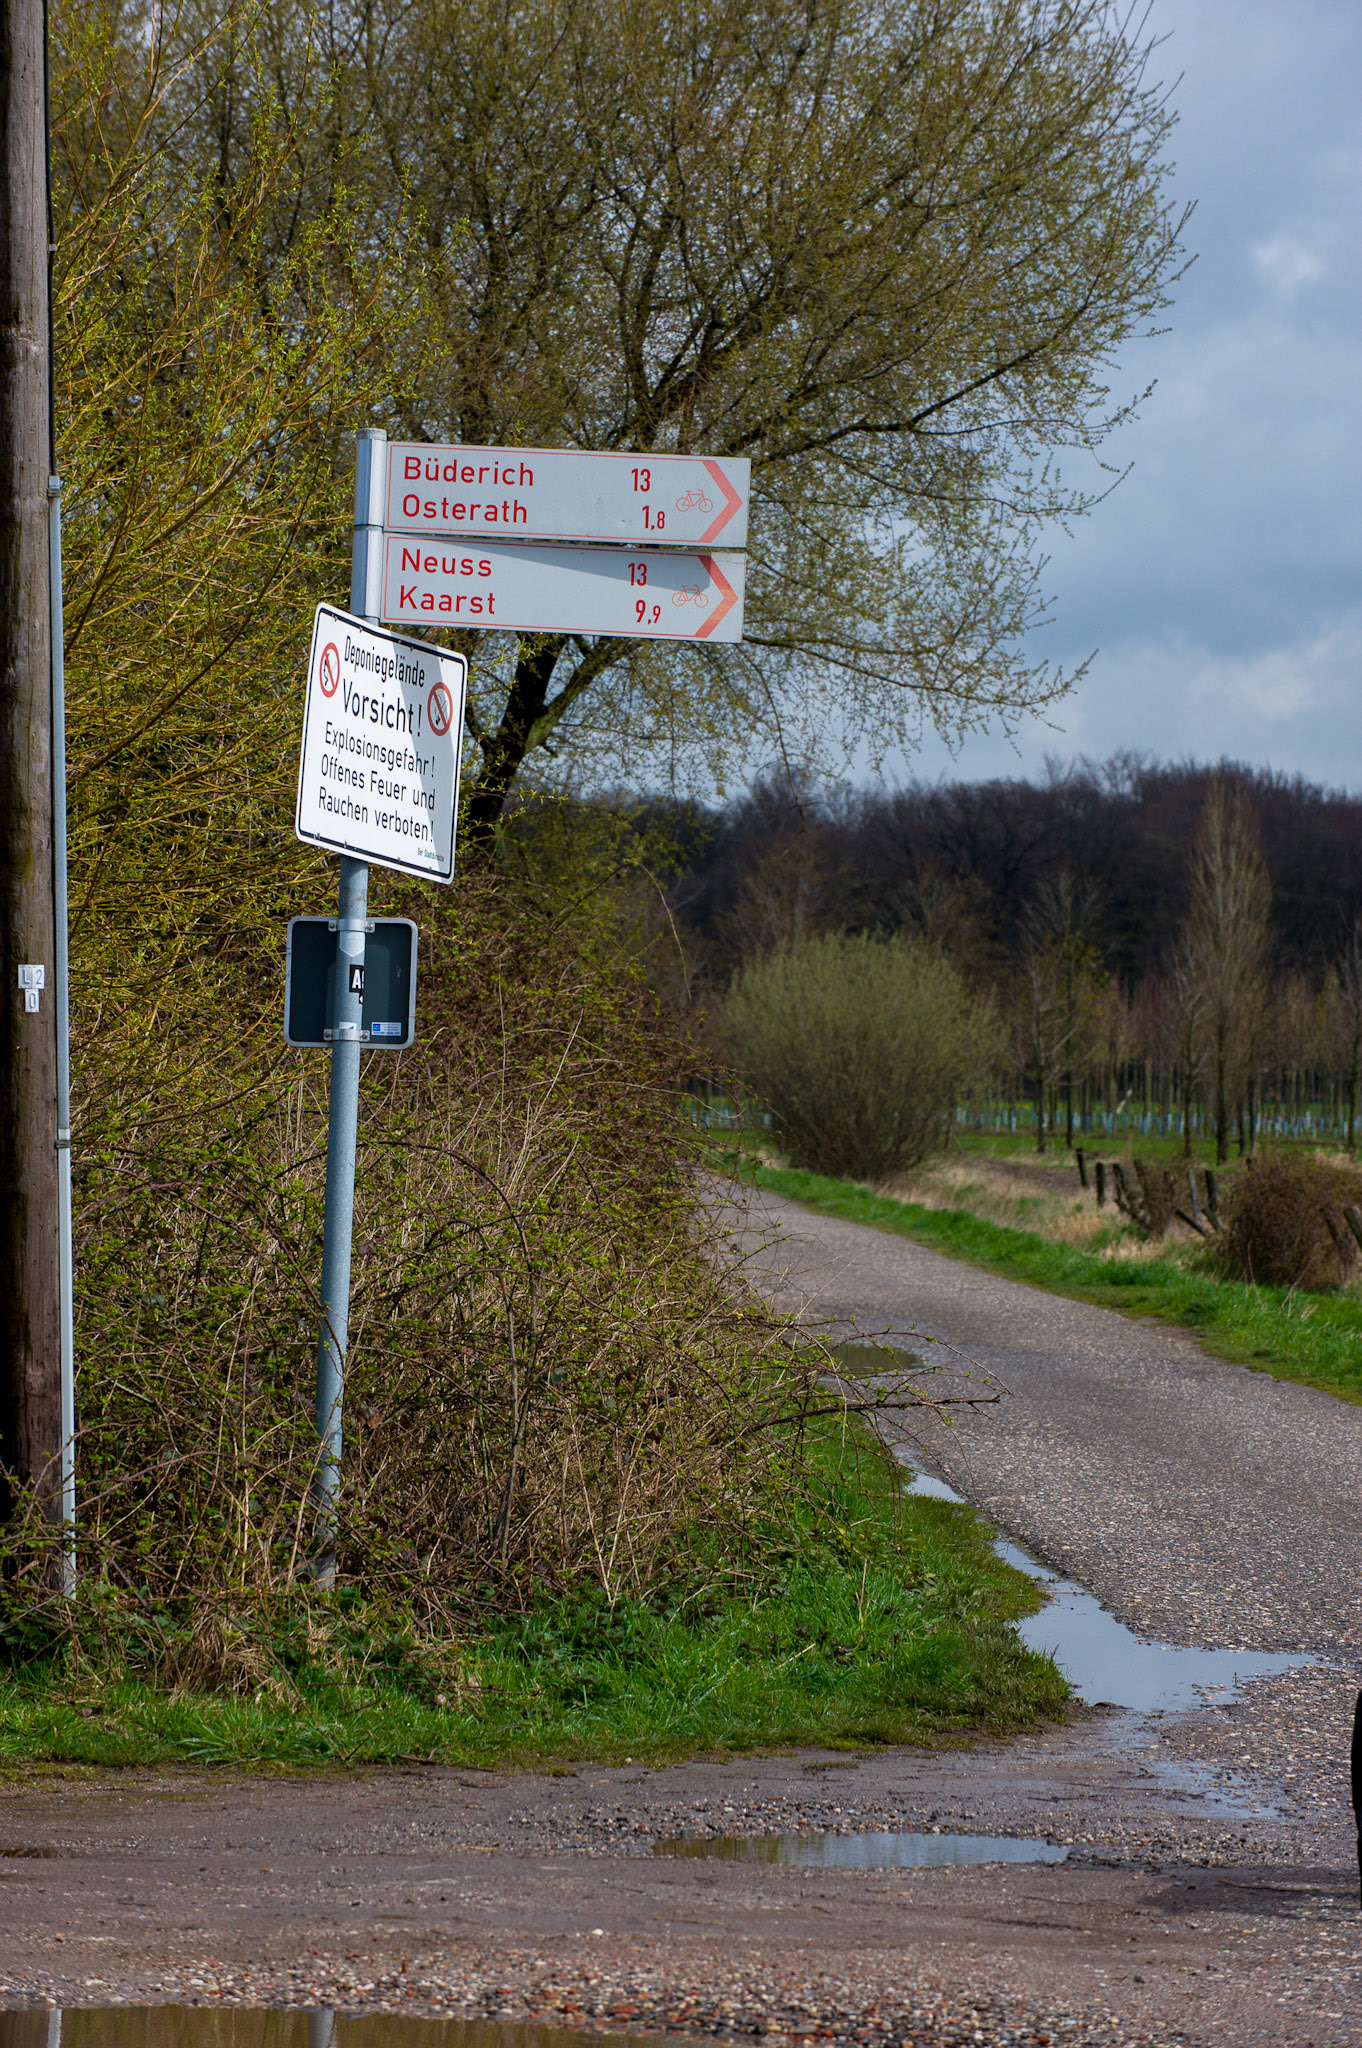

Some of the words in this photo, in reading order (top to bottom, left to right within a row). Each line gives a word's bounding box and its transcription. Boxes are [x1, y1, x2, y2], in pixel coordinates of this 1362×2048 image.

[404, 456, 534, 486] Büderich
[631, 468, 651, 492] 13
[402, 494, 527, 523] Osterath
[642, 505, 665, 530] 1,8
[401, 548, 492, 577] Neuss
[628, 563, 648, 586] 13
[400, 585, 496, 615] Kaarst
[635, 600, 661, 624] 9,9
[344, 635, 425, 687] Deponiegelände
[321, 754, 365, 789] Offenes
[370, 770, 407, 801] Feuer
[412, 789, 435, 811] und
[319, 786, 369, 823] Rauchen
